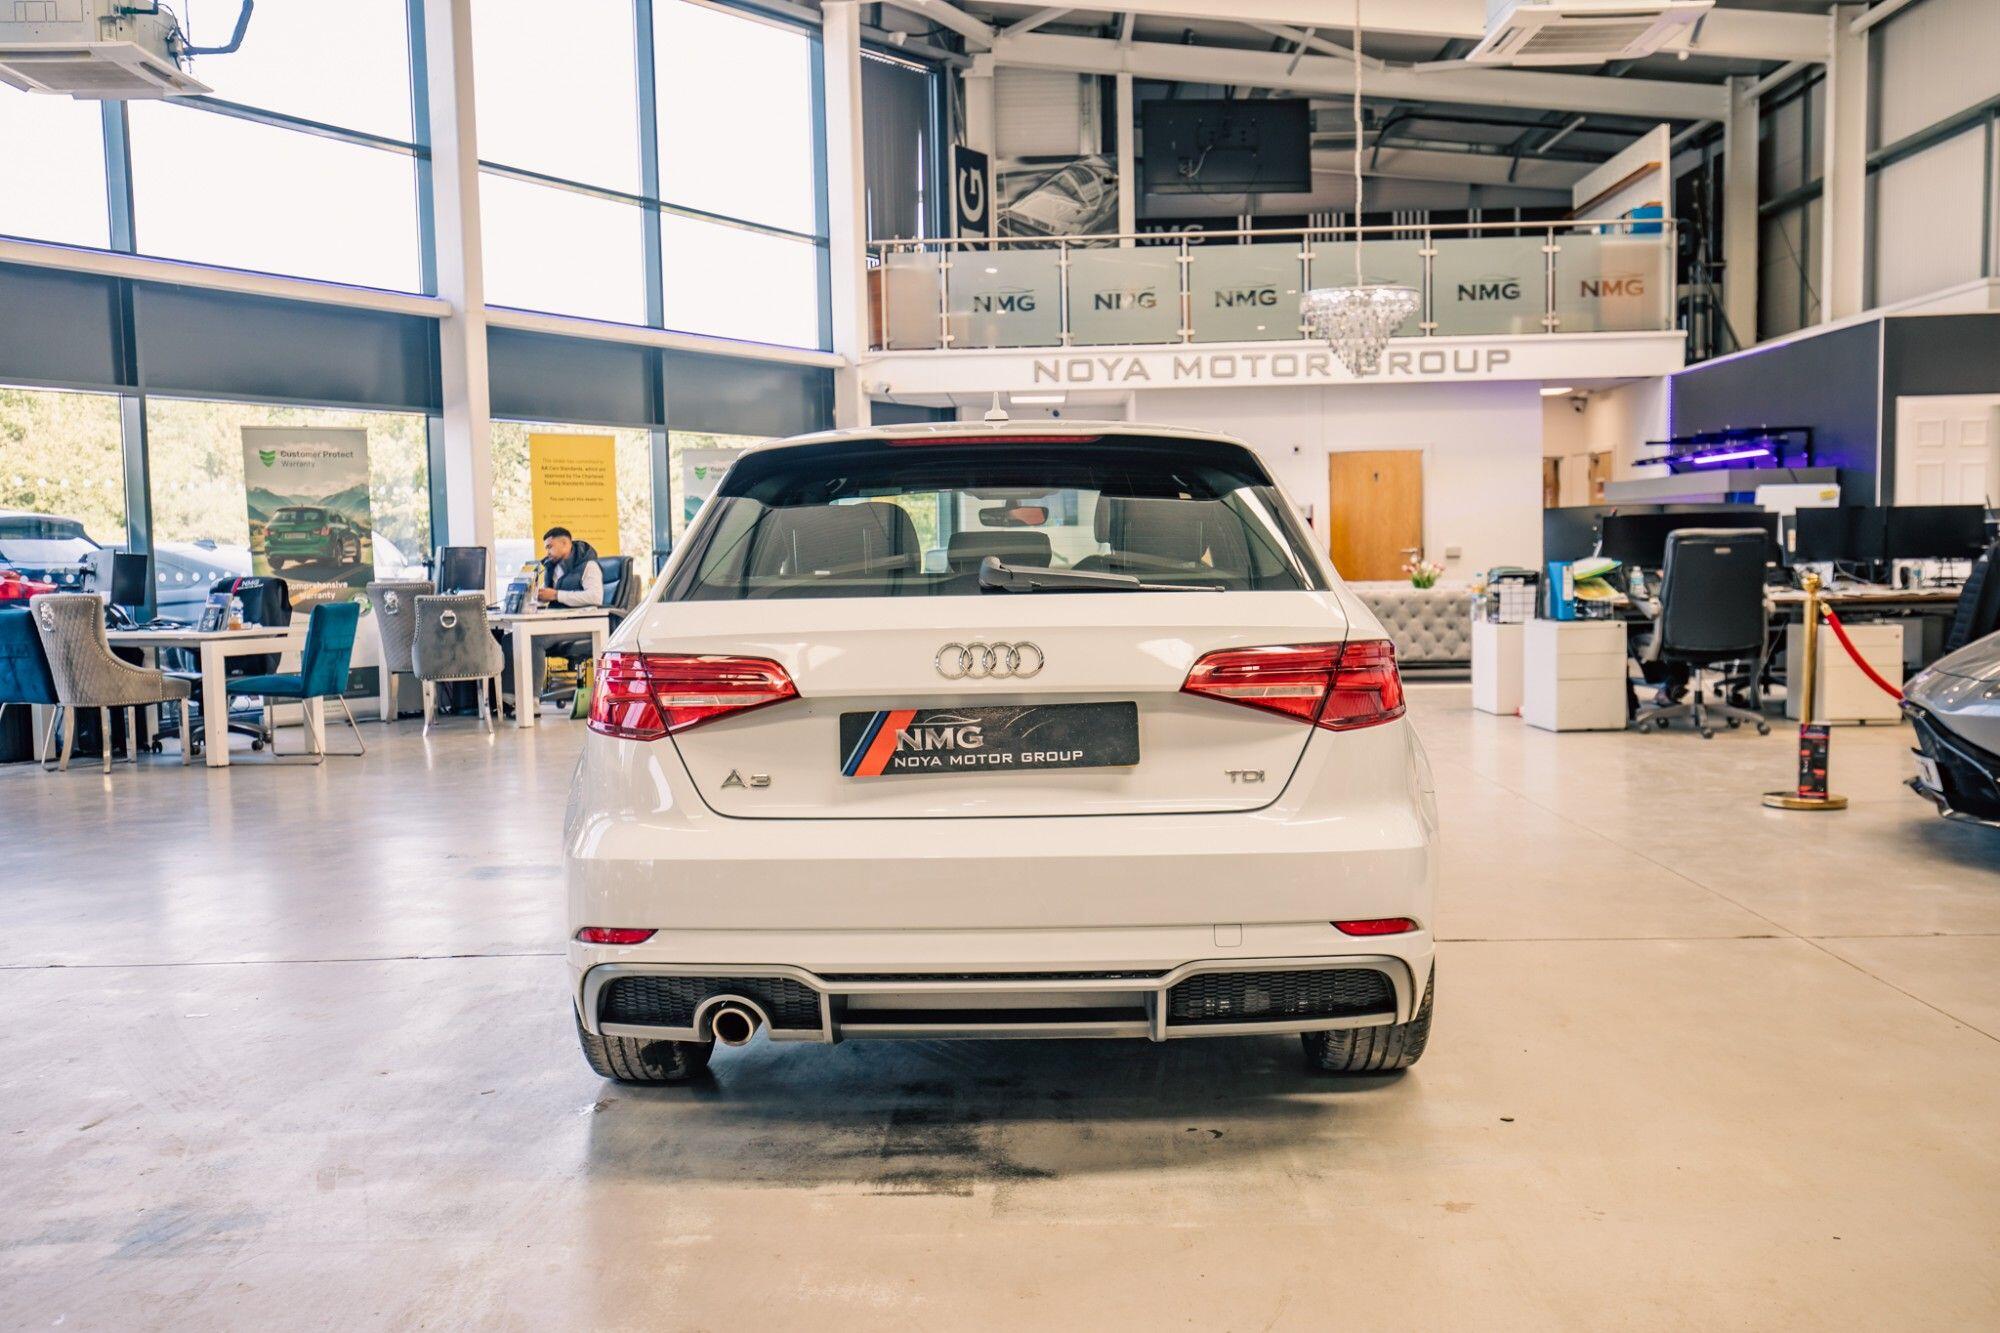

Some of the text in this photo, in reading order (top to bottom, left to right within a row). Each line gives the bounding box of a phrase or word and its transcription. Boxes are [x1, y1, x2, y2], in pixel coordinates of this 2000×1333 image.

[1457, 283, 1521, 301] NMG
[1581, 279, 1644, 298] NMG
[973, 295, 1036, 313] NMG
[1215, 289, 1277, 308] NMG
[1033, 356, 1151, 383] NOYA
[1173, 353, 1331, 380] MOTOR
[322, 450, 354, 459] Protect
[896, 725, 984, 752] NMG
[894, 750, 1084, 768] NOYA MOTOR GROUP
[721, 769, 771, 789] A3
[1224, 769, 1265, 784] TDI
